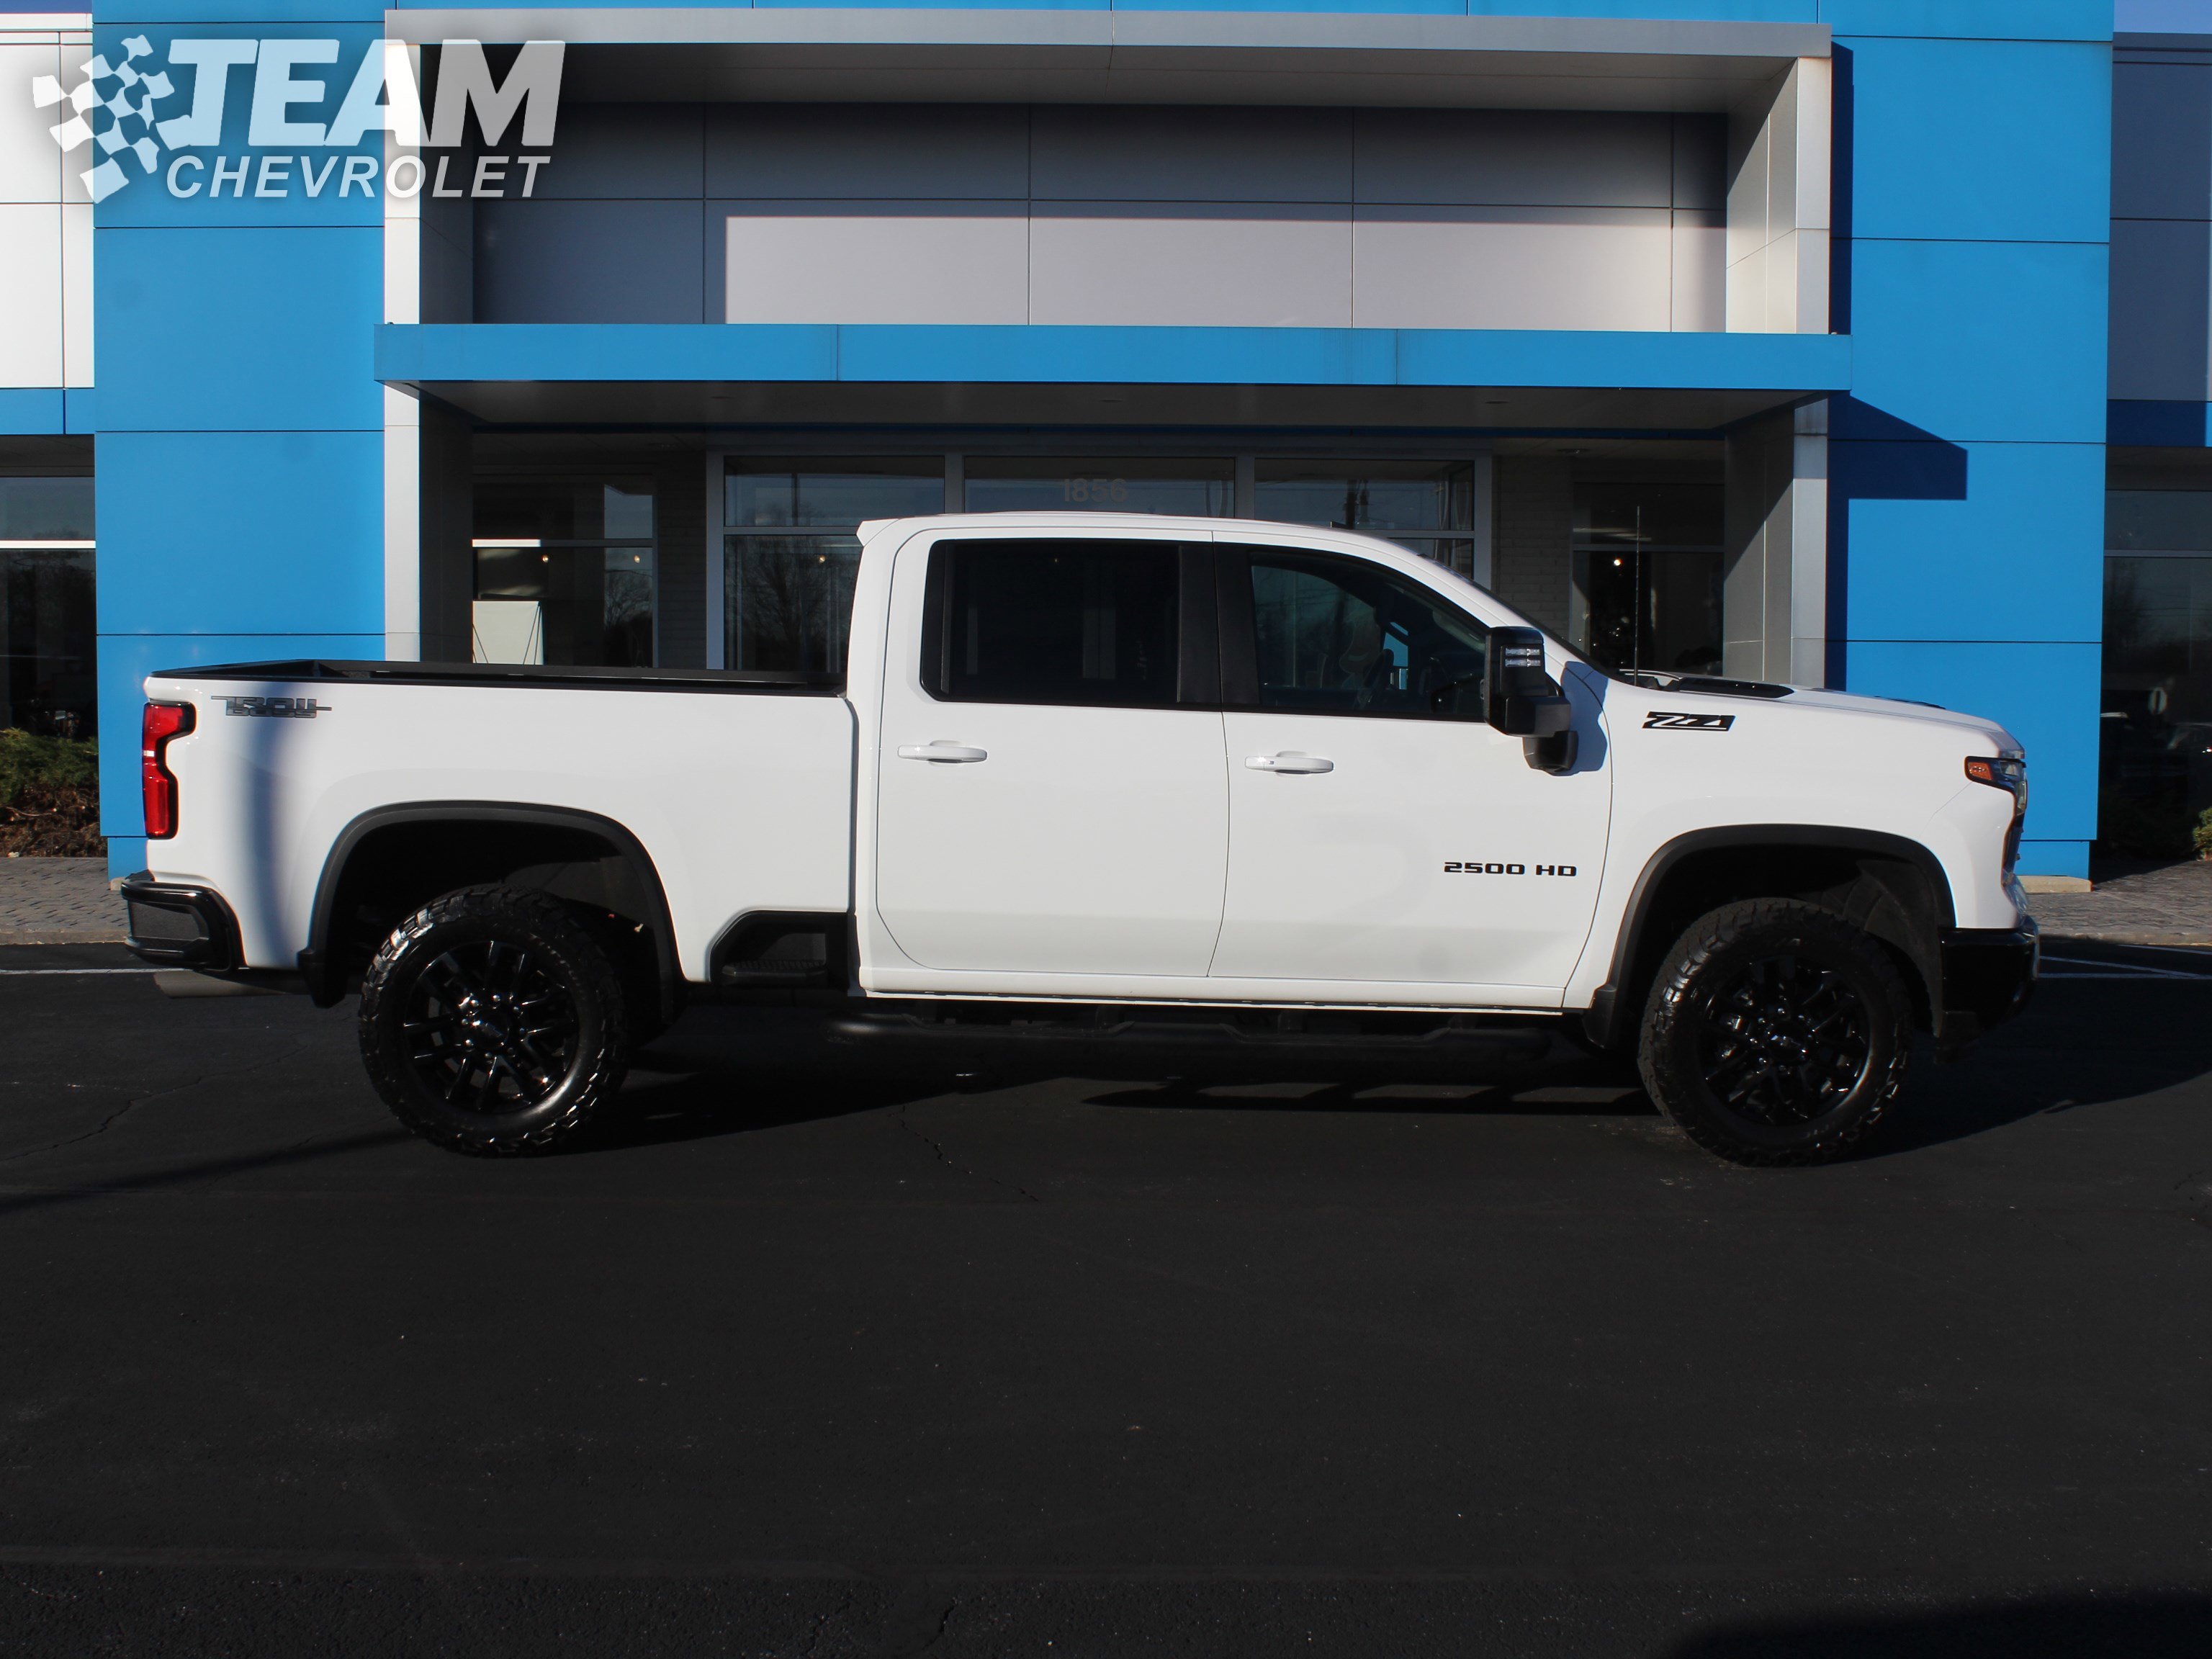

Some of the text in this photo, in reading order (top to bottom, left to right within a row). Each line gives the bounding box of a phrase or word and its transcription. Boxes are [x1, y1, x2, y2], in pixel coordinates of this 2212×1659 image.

[1064, 477, 1129, 503] 1856
[1444, 862, 1577, 877] 2500 HD
